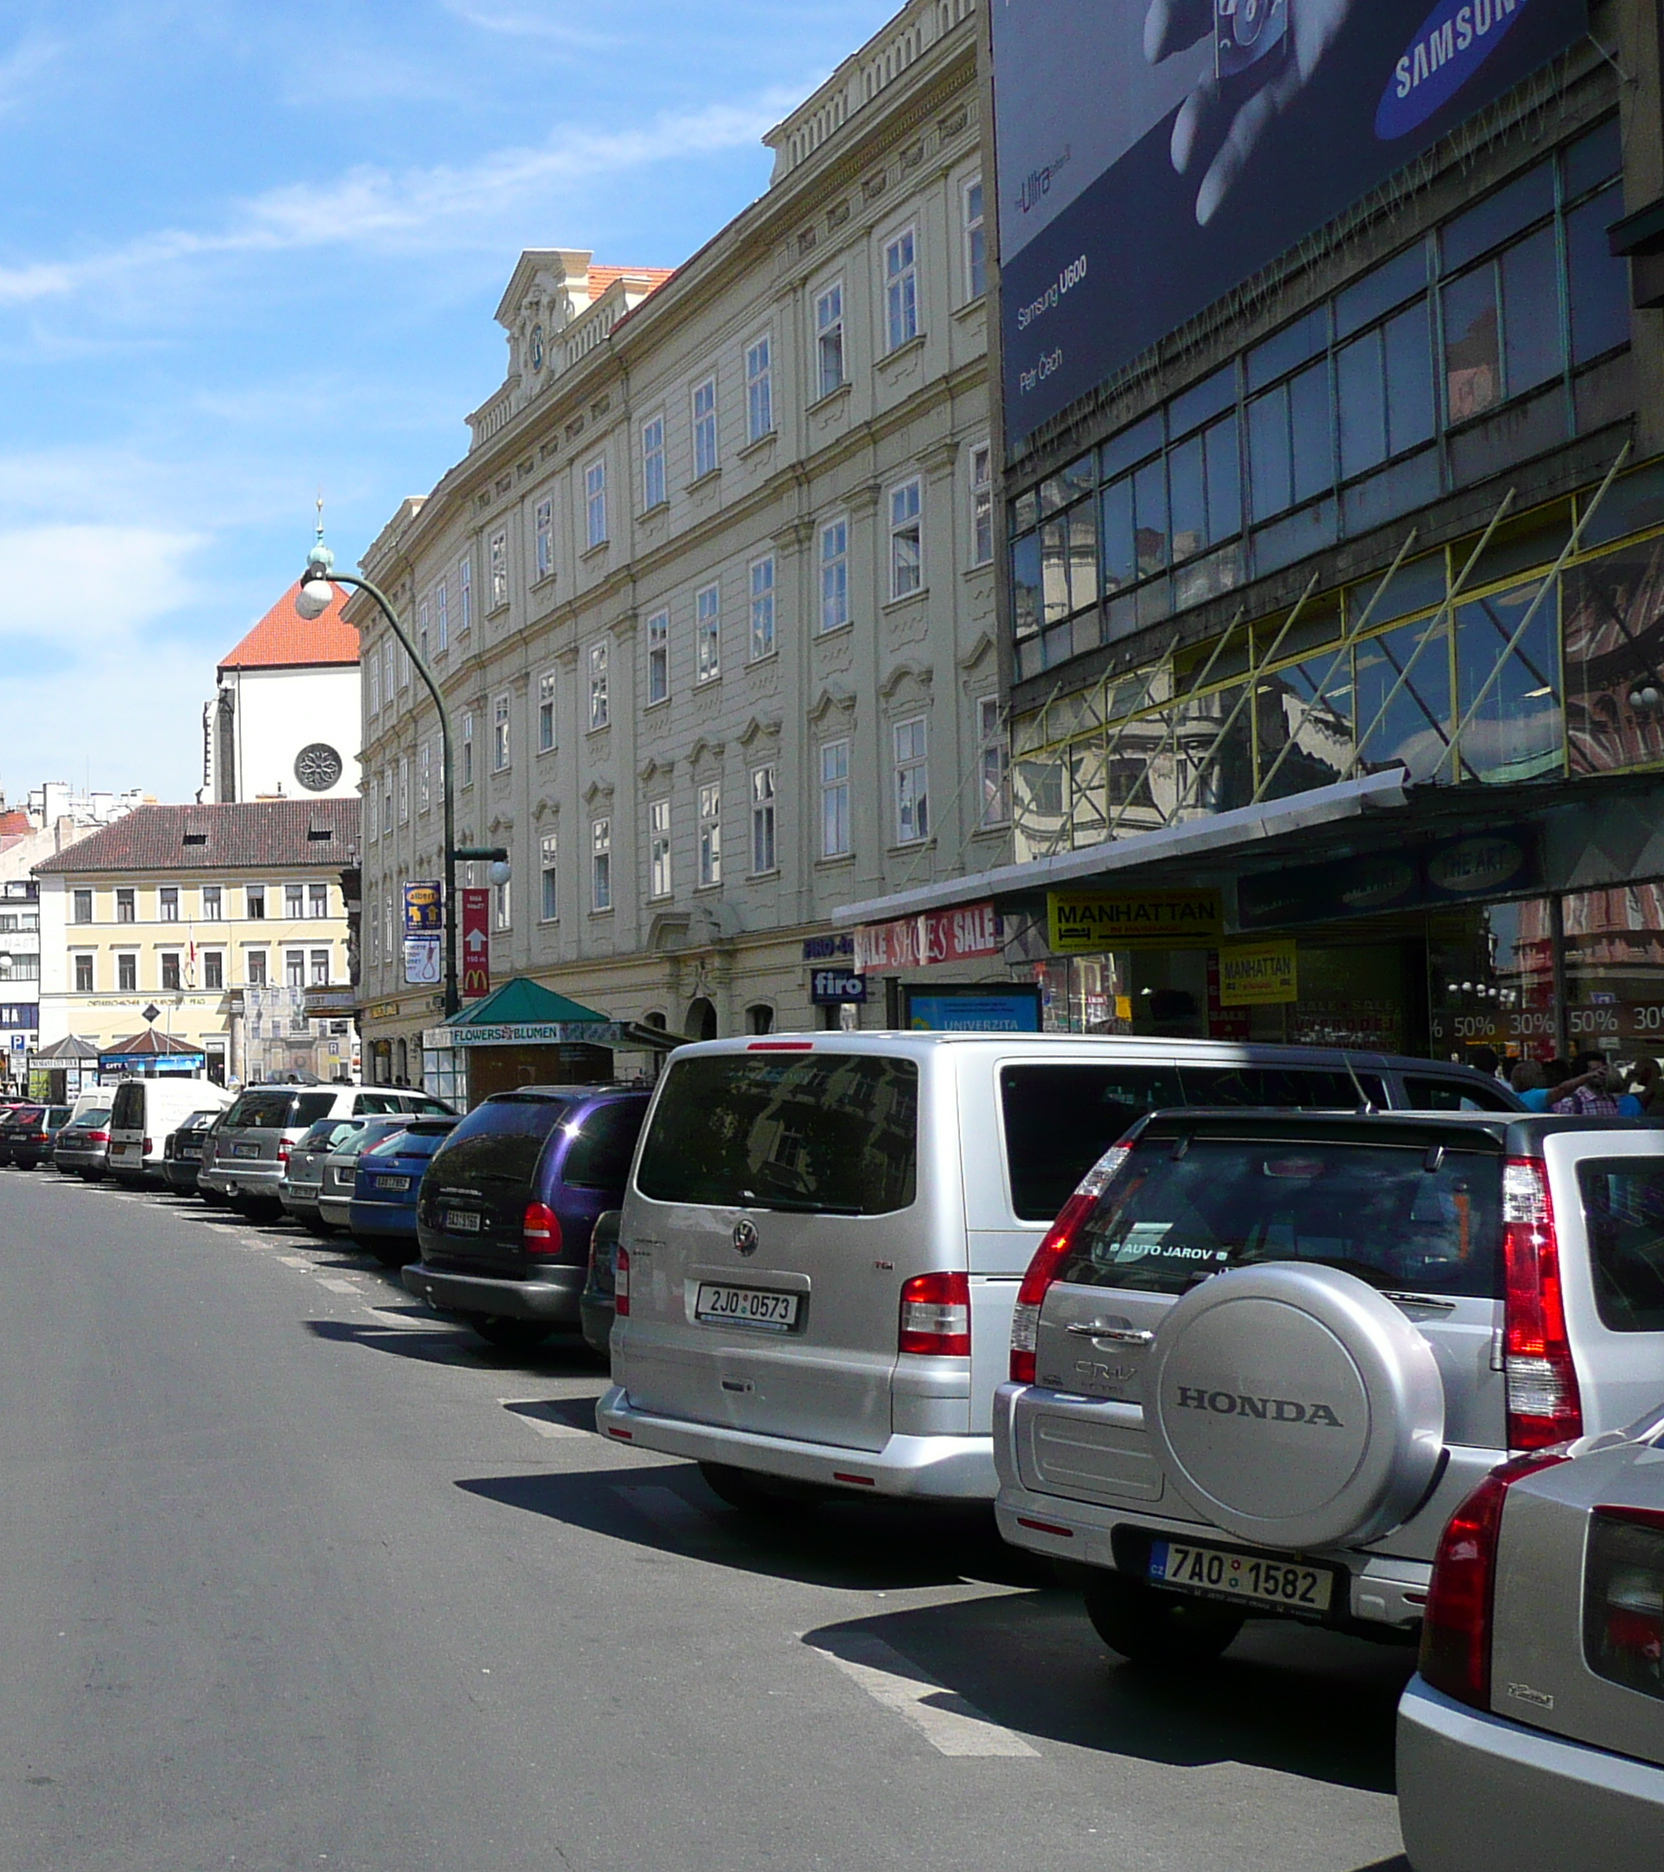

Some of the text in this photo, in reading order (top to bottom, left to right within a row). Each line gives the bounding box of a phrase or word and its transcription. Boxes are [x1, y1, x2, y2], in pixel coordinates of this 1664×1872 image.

[1396, 0, 1527, 98] SAMSUN
[1018, 254, 1087, 331] Samsung U600
[1020, 368, 1038, 396] Petr
[1058, 902, 1216, 924] MANHATTAN
[953, 907, 995, 954] SALE
[1224, 957, 1291, 979] MANHATTAN
[814, 972, 862, 995] firo
[943, 1019, 1019, 1031] UNIVERZITA
[1454, 1015, 1496, 1037] 50%
[1509, 1012, 1555, 1035] 30%
[1570, 1009, 1618, 1033] 50%
[1633, 1006, 1664, 1030] 30
[13, 1036, 23, 1050] P
[454, 1029, 503, 1041] FLOWERS
[513, 1026, 557, 1040] BLUMEN
[1125, 1243, 1213, 1261] AUTO JAROV
[710, 1290, 791, 1320] 2J0 0573
[1074, 1360, 1137, 1381] CR-V
[1177, 1386, 1344, 1428] HONDA
[1150, 1564, 1165, 1576] CZ
[1171, 1548, 1319, 1604] 7A0 1582
